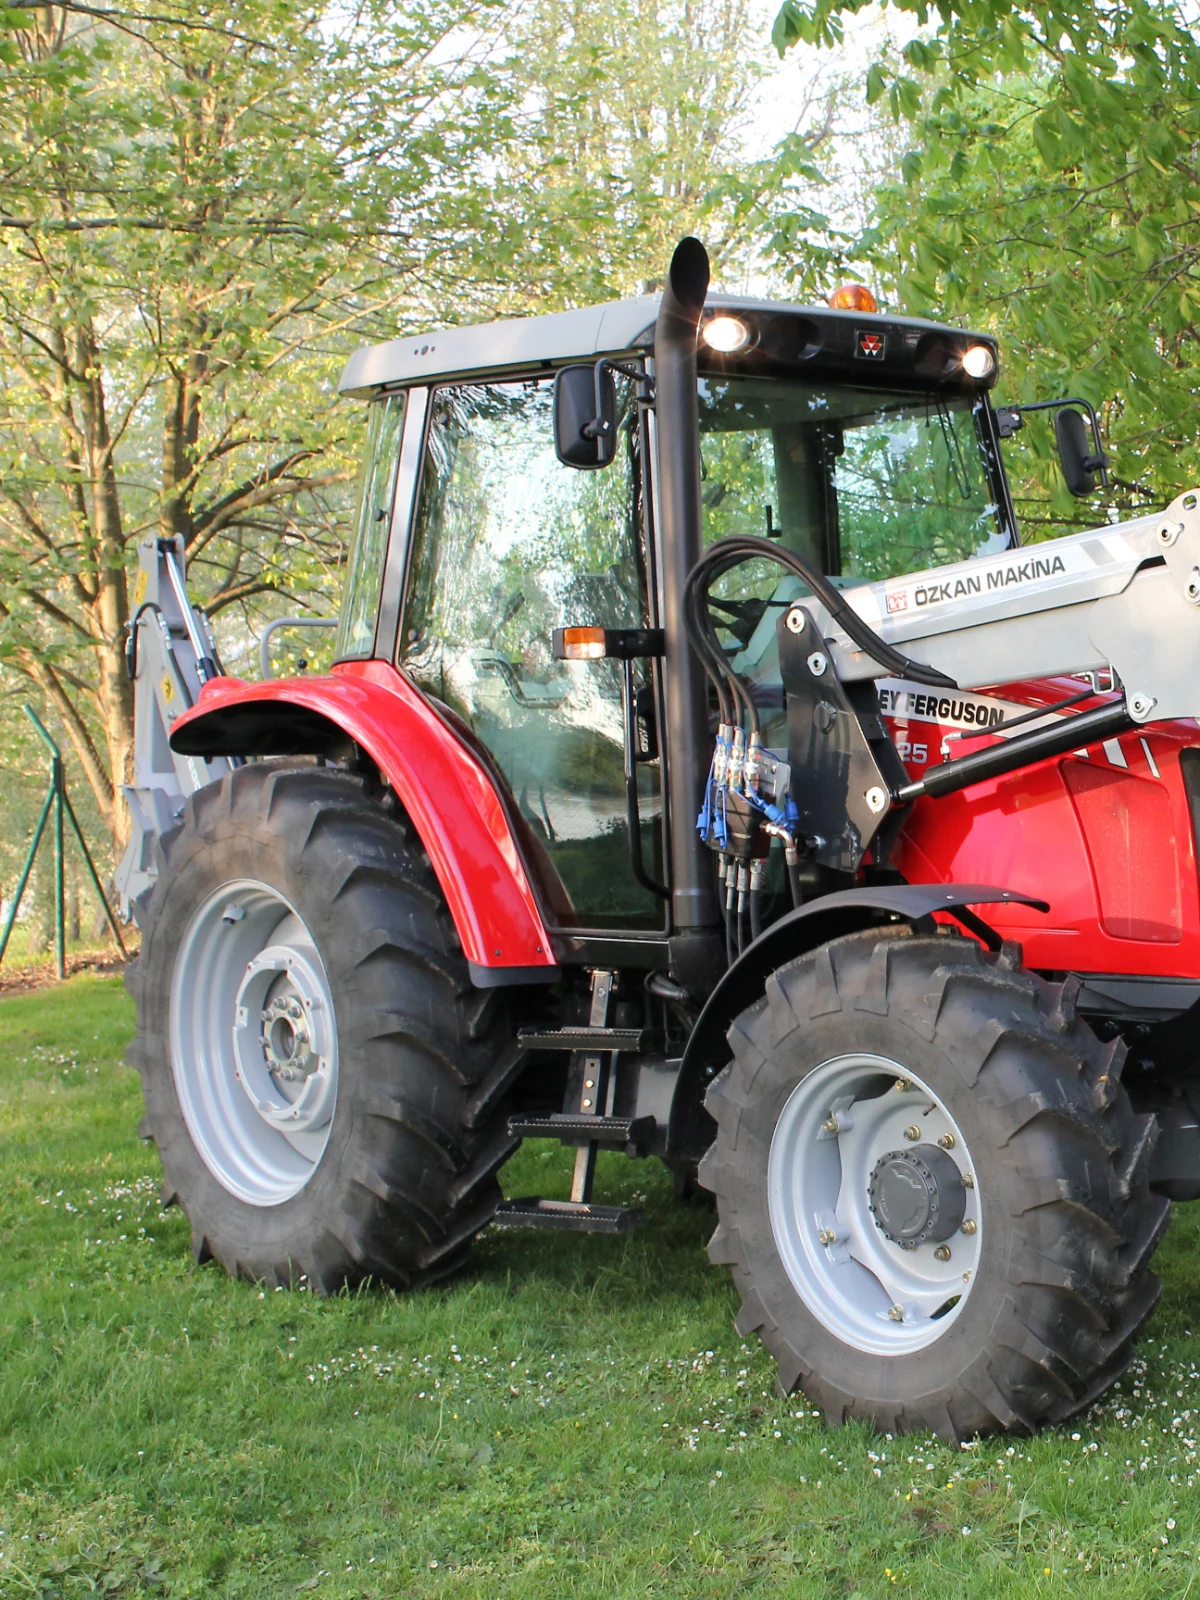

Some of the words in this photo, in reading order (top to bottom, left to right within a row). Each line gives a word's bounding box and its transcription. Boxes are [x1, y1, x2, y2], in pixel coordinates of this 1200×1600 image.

[914, 575, 982, 606] ÖZKAN
[986, 556, 1066, 589] MAKİNA
[880, 689, 901, 711] EY
[905, 692, 1005, 727] FERGUSON
[896, 741, 928, 764] 25
